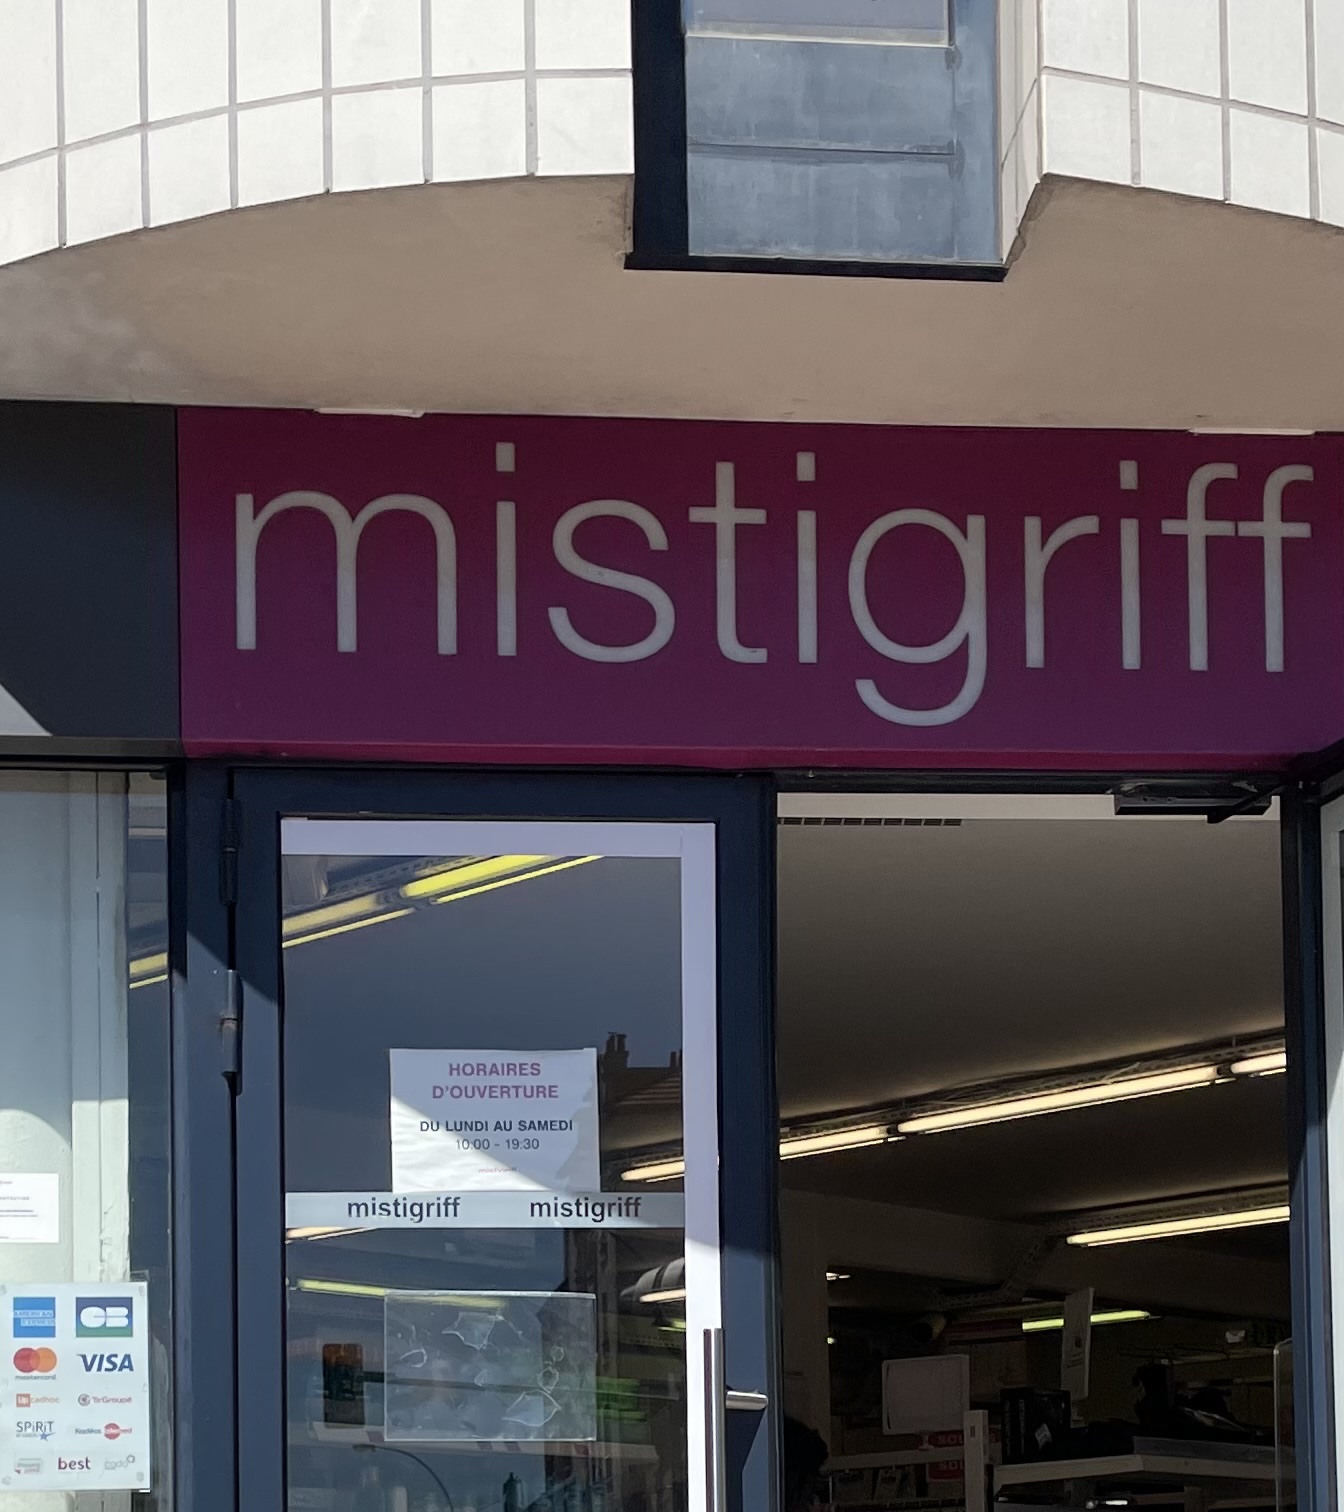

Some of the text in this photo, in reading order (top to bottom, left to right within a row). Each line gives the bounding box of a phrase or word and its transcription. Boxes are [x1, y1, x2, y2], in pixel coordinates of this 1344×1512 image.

[234, 440, 1315, 727] mistigriff
[448, 1062, 542, 1077] HORAIRES
[432, 1085, 560, 1099] D'OUVERTURE
[420, 1119, 573, 1132] DU LUNDI AU SAMEDI
[455, 1138, 491, 1150] 10:00
[505, 1138, 540, 1150] 19:30
[347, 1196, 642, 1223] mistigriff mistigriff
[77, 1353, 134, 1373] VISA
[57, 1456, 92, 1471] best
